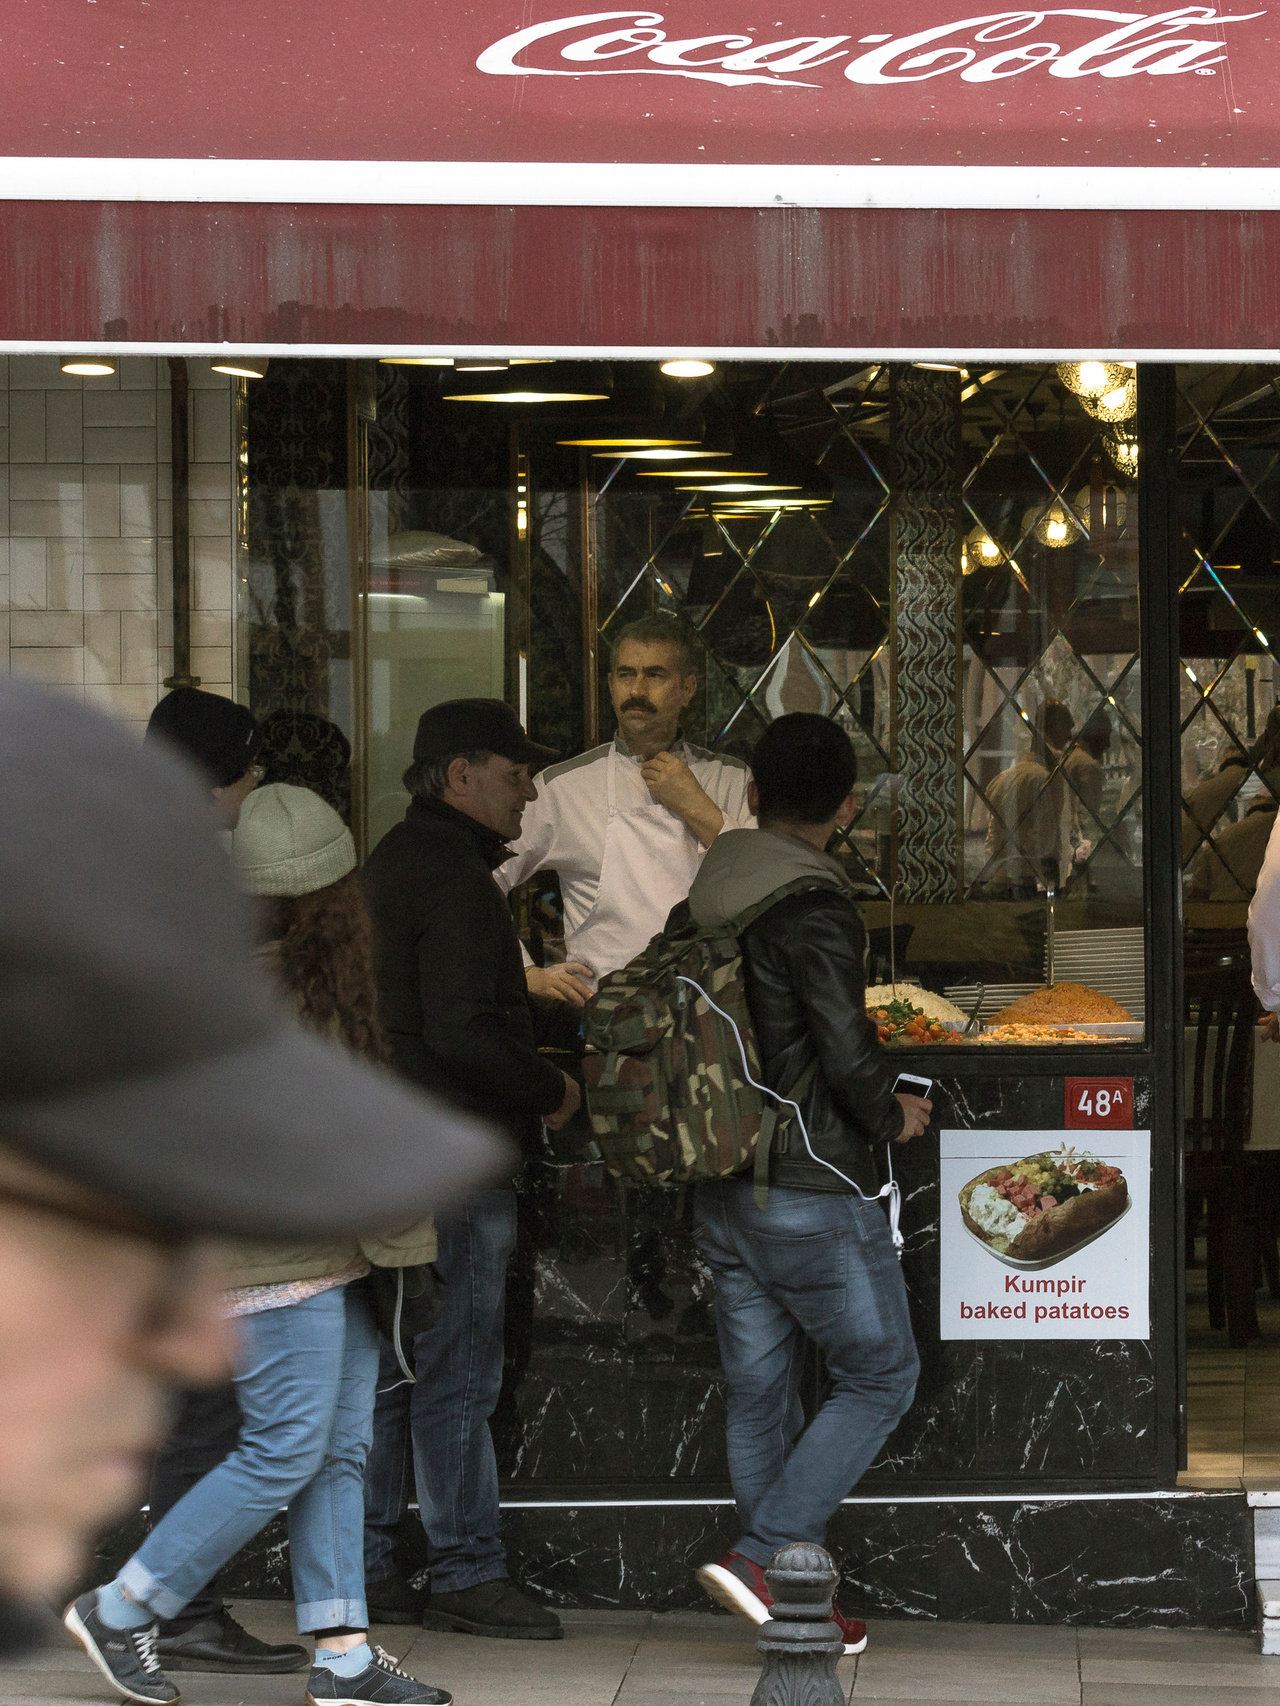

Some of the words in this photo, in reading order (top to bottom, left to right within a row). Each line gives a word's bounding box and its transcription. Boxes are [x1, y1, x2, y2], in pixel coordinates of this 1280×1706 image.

[475, 6, 1268, 88] Coca-Cola
[1077, 1089, 1123, 1117] 48A
[1004, 1275, 1087, 1298] Kumpir
[960, 1302, 1027, 1320] baked
[1034, 1302, 1130, 1323] patatoes
